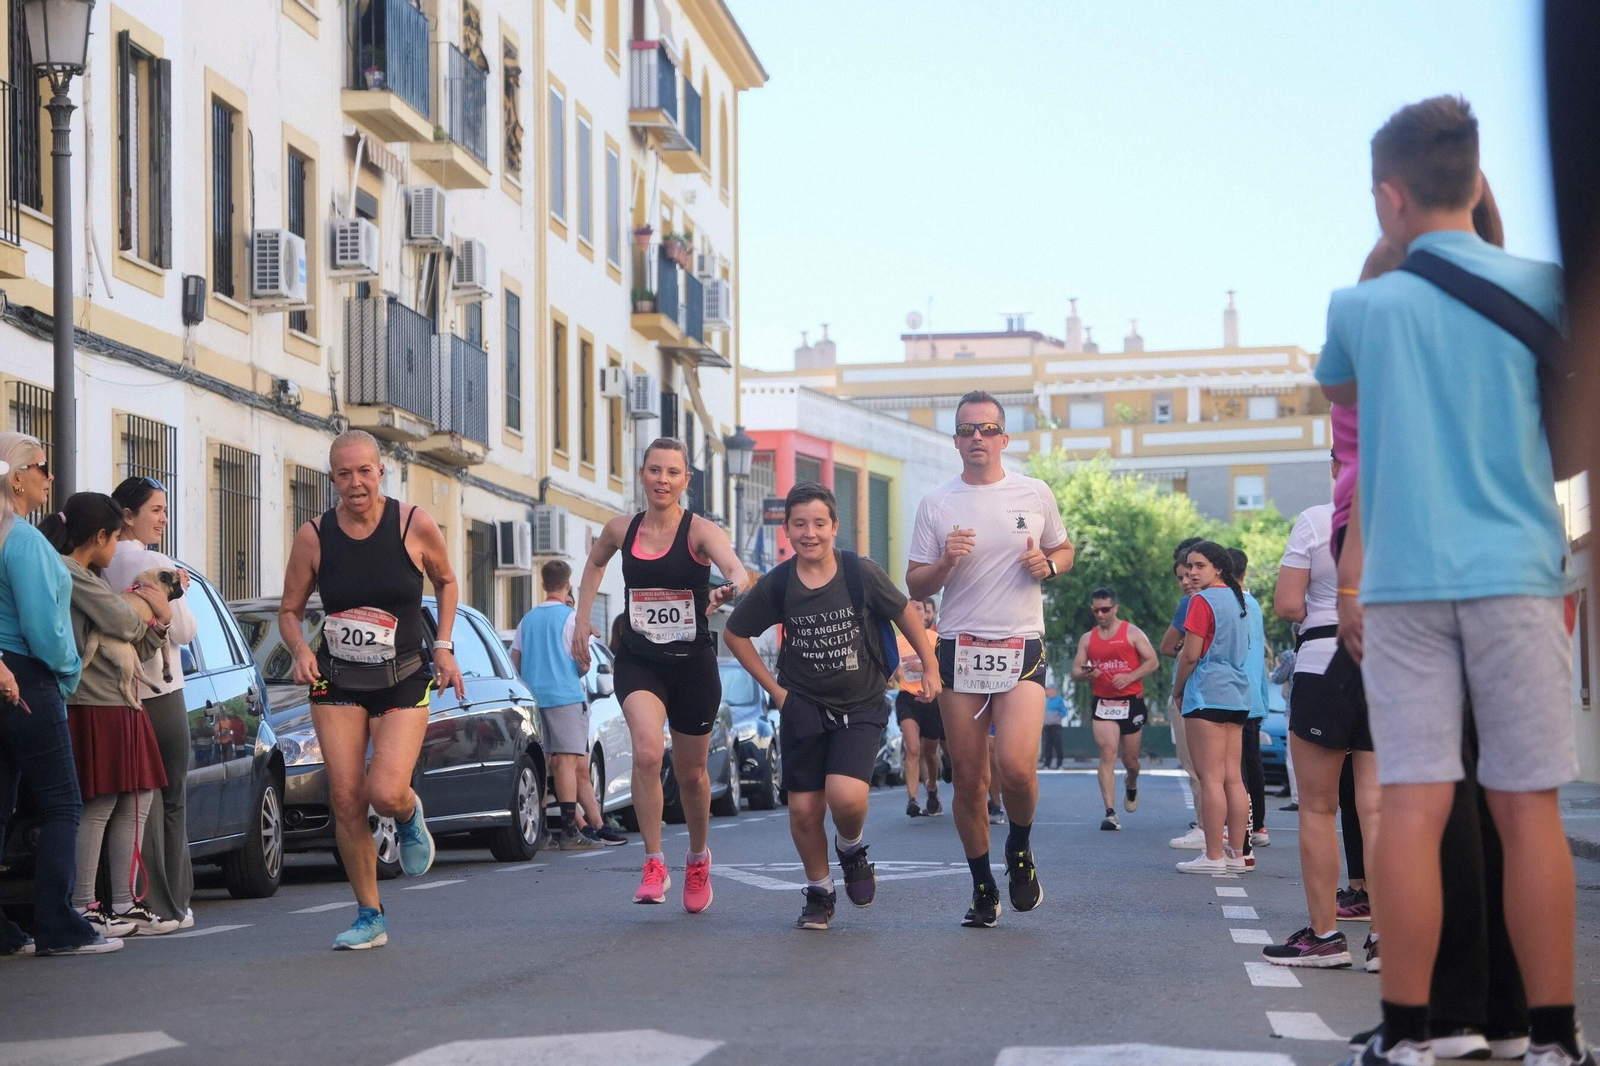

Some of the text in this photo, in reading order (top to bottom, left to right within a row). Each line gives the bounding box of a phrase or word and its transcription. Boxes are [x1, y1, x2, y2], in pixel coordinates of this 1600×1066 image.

[646, 607, 680, 625] 260
[791, 606, 855, 626] NEW YORK
[341, 627, 377, 647] 202
[797, 620, 852, 636] LOS ANGELES
[791, 626, 860, 649] LOS ANGELES
[802, 644, 854, 660] NEW YORK
[973, 654, 1007, 672] 135
